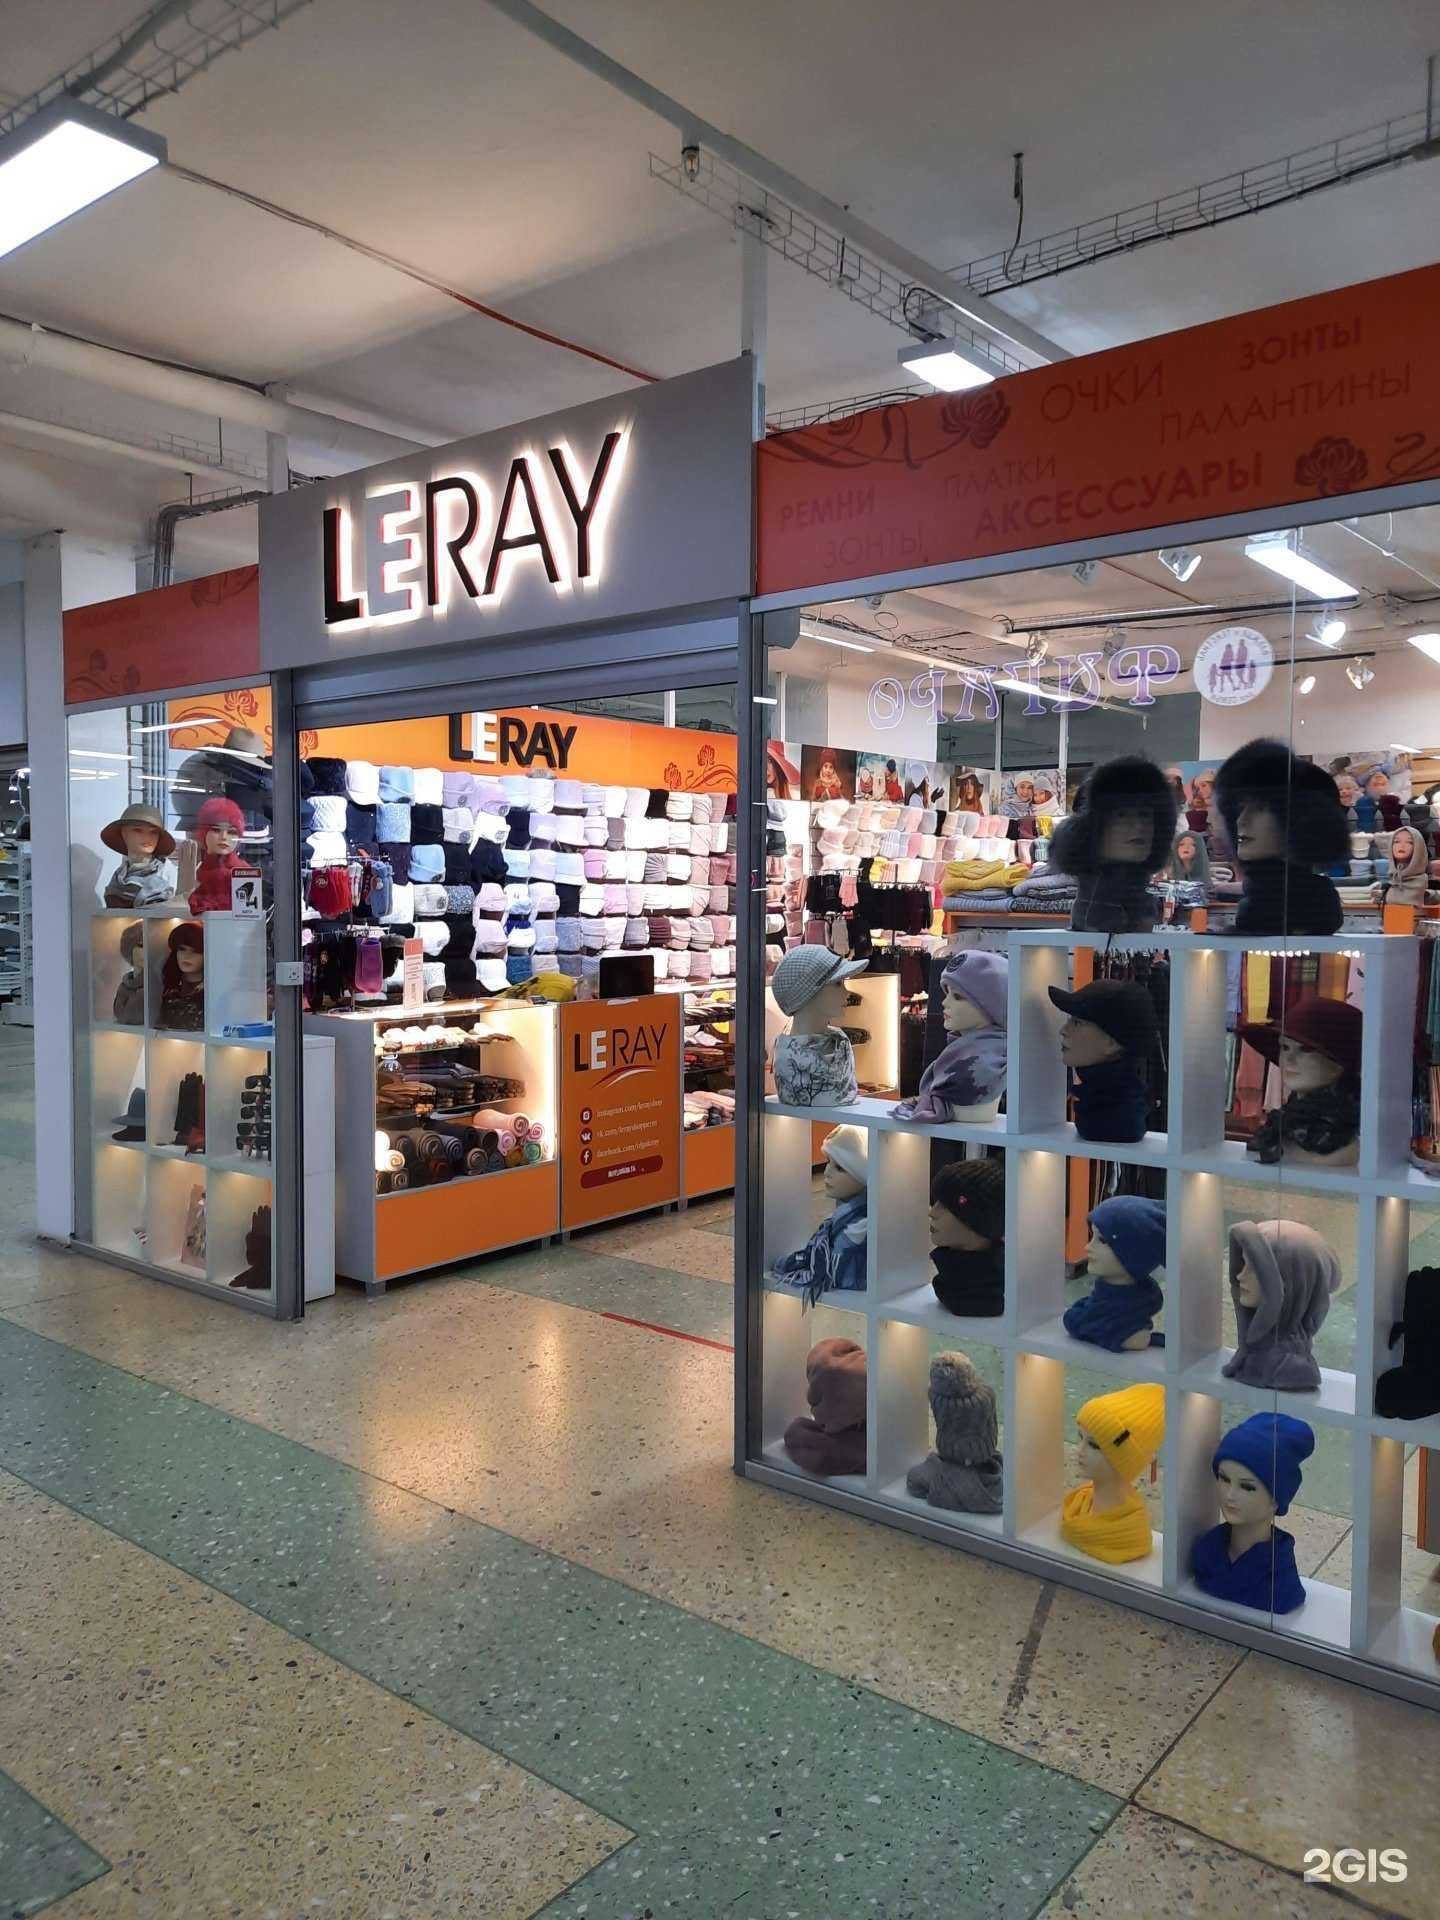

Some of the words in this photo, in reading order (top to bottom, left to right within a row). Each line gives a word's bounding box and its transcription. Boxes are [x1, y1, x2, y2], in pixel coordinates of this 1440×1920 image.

[1239, 317, 1363, 372] ЗОНТЫ
[1041, 359, 1165, 424] ОЧКИ
[1160, 361, 1411, 445] ПАЛАНТИНЫ
[943, 454, 1057, 499] ПЛАТКИ
[974, 451, 1263, 540] АКСЕССУАРЫ
[324, 432, 621, 625] LERAY
[780, 486, 876, 531] РЕМНИ
[822, 523, 924, 572] ЗОНТЫ
[448, 710, 578, 769] LERAY
[573, 1023, 668, 1073] LERAY
